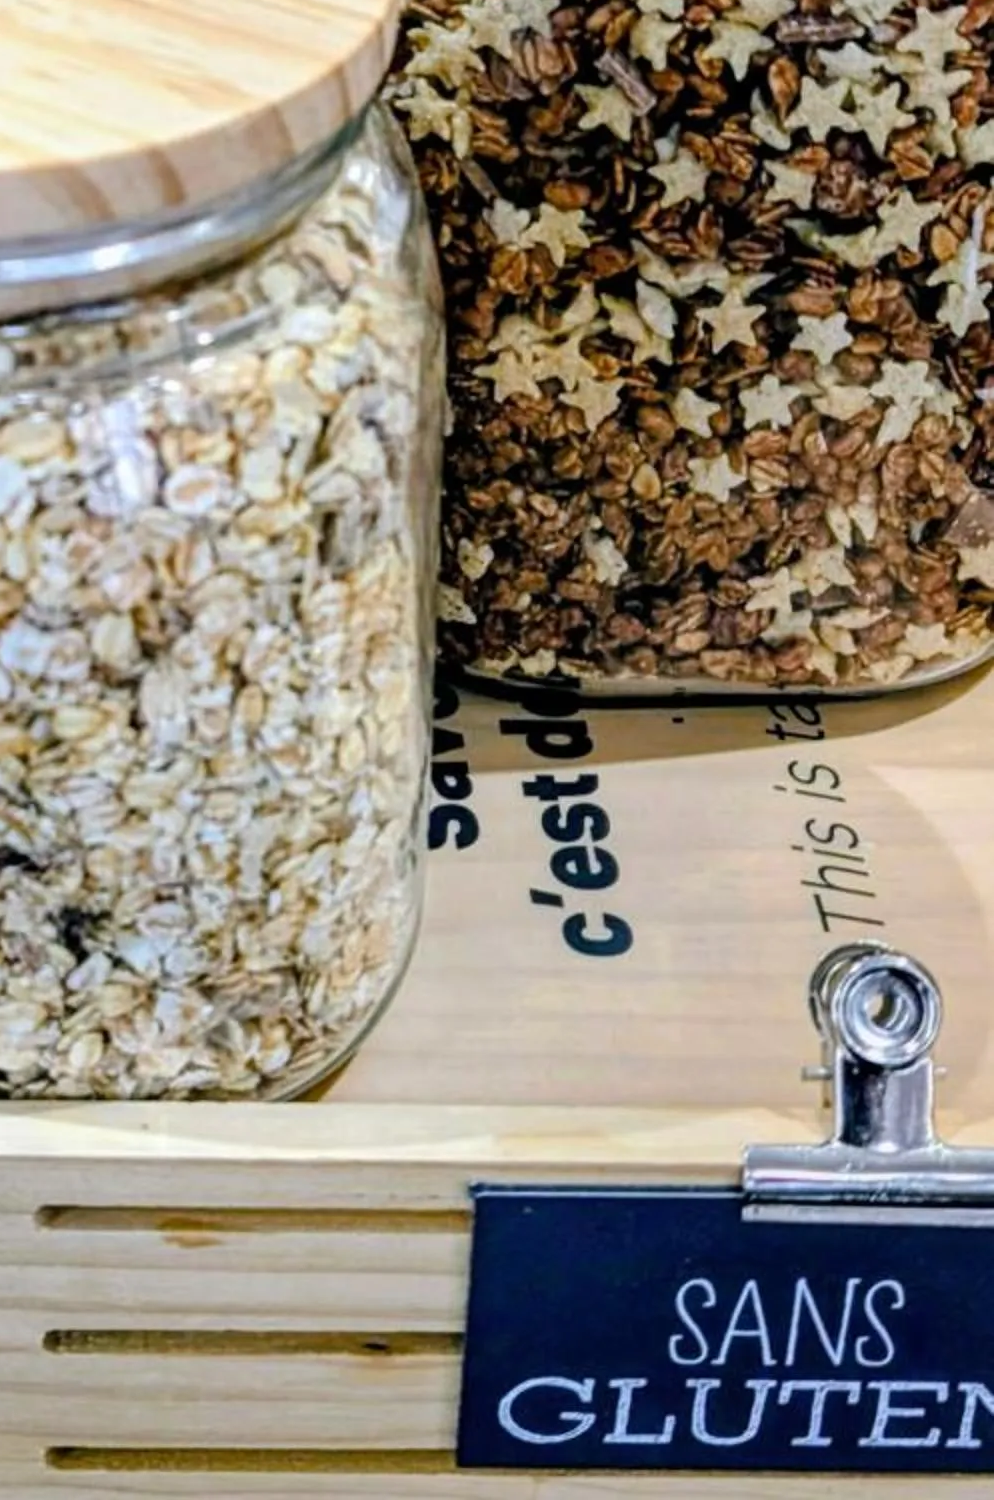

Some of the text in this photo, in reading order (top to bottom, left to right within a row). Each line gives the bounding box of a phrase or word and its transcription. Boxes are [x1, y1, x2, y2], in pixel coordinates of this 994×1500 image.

[522, 773, 634, 957] c'est
[765, 686, 885, 932] This is ta
[669, 1278, 905, 1366] SANS
